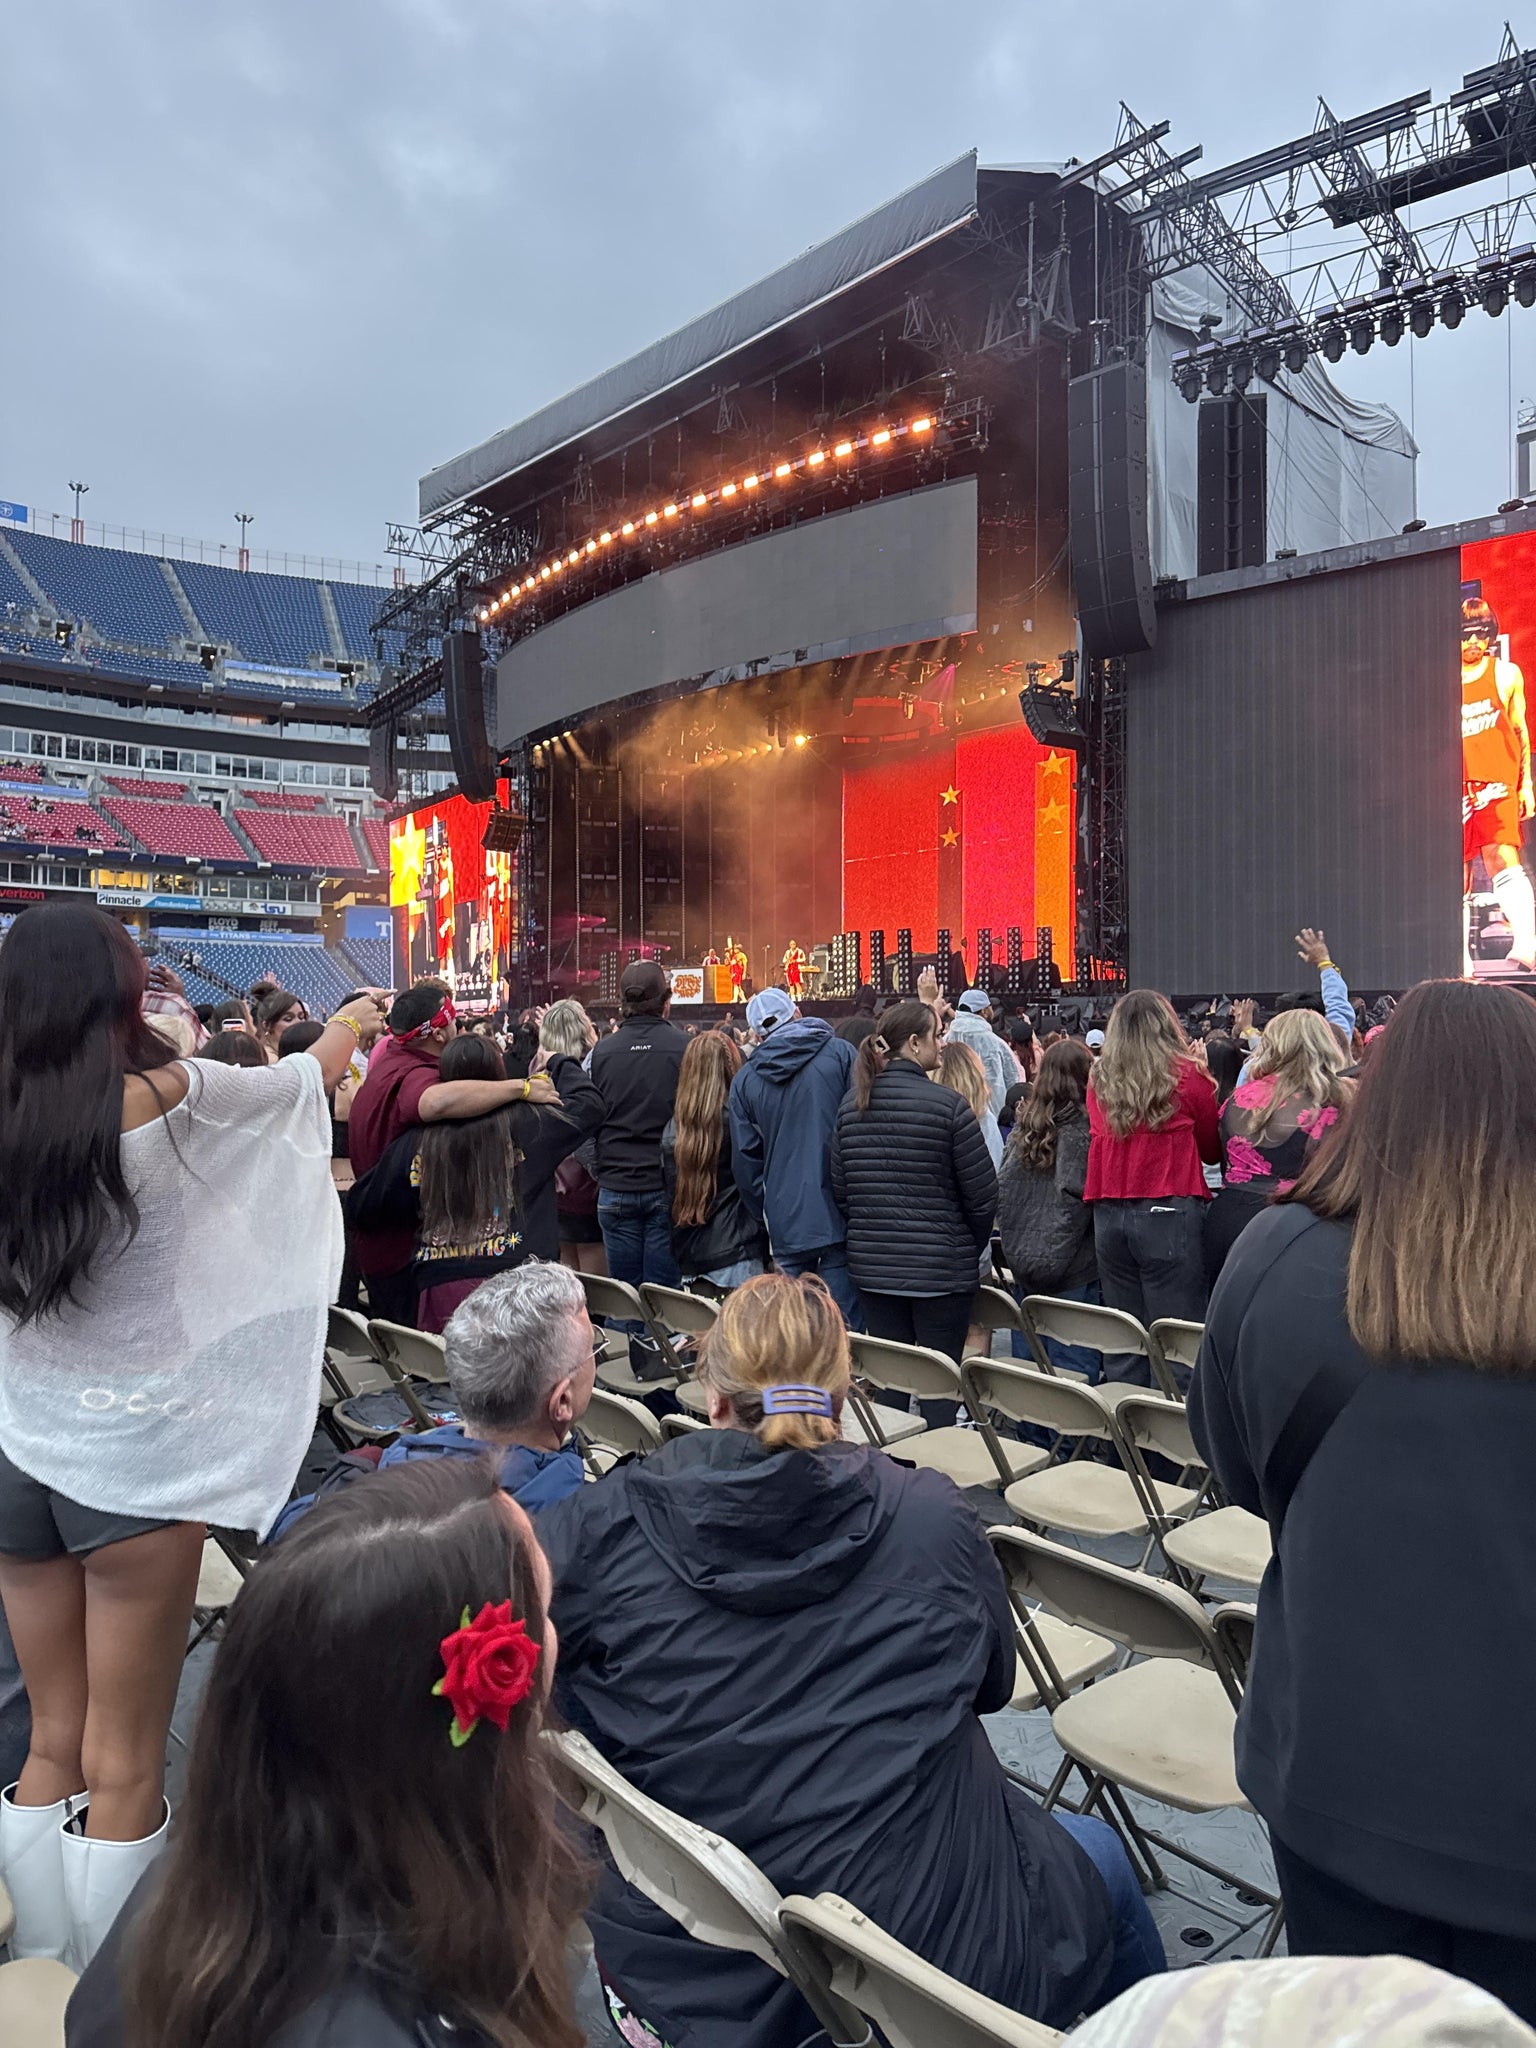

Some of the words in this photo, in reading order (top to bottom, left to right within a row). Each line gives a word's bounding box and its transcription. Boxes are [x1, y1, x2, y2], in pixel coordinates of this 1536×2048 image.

[0, 888, 46, 900] verizon
[98, 893, 141, 906] Pinnacle
[208, 917, 239, 926] FLOYD
[259, 920, 279, 928] JEFF
[220, 931, 251, 940] TITANS
